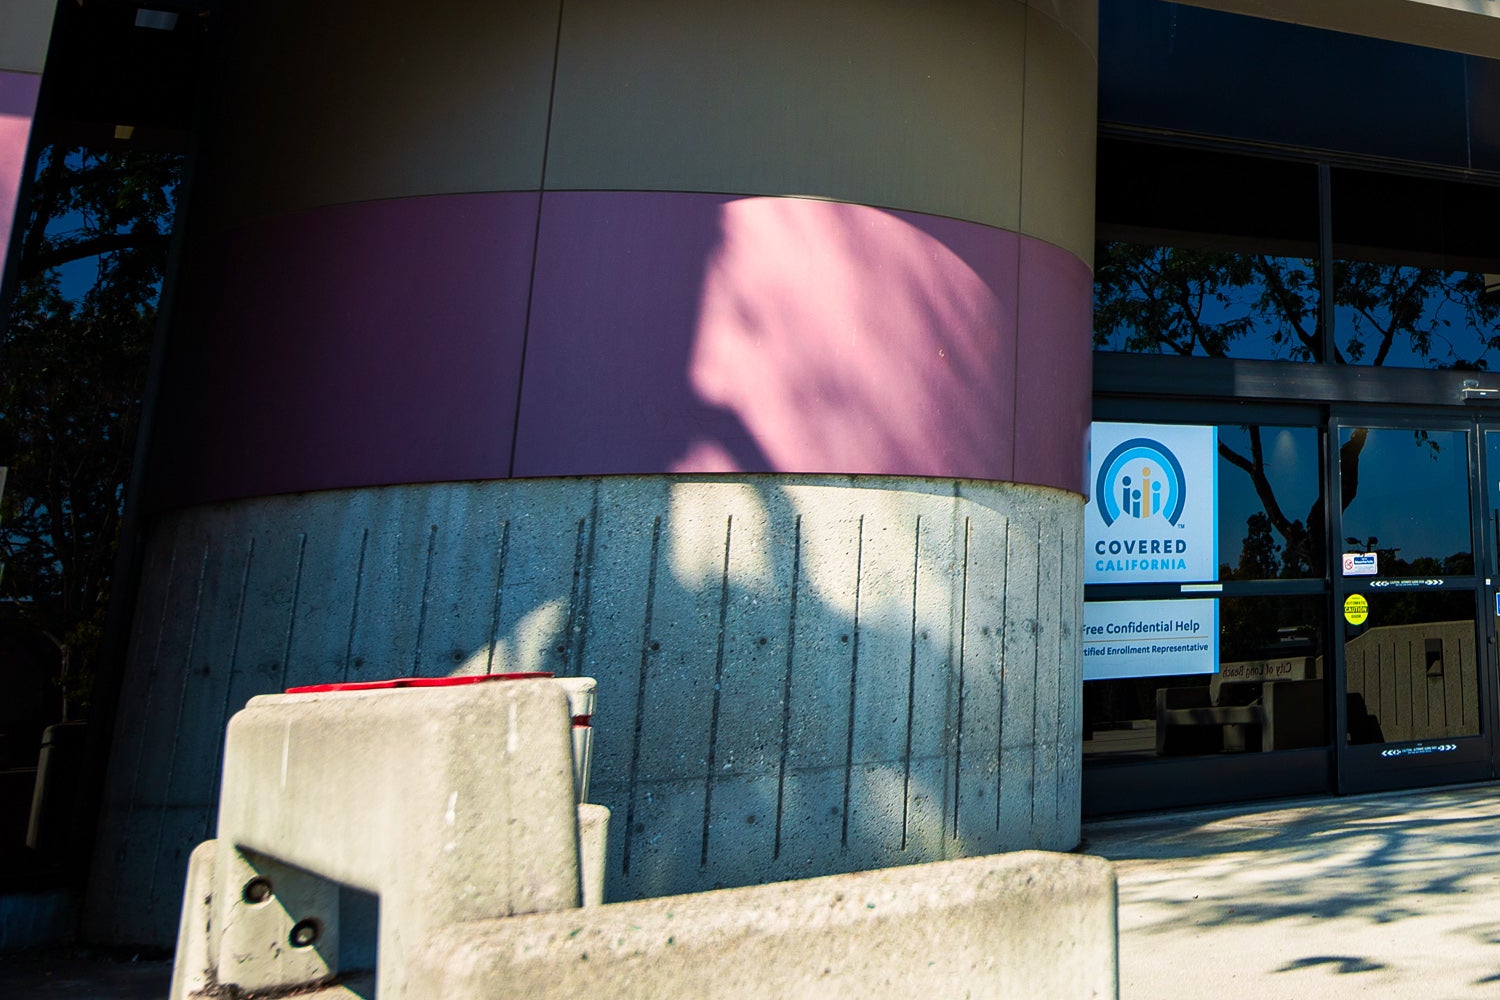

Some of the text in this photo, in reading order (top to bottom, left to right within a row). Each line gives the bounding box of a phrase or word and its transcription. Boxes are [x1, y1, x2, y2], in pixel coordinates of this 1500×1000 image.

[1095, 539, 1187, 555] COVERED
[1095, 558, 1187, 572] CALIFORNIA
[1106, 620, 1173, 634] Confidential
[1175, 619, 1200, 633] Help
[1083, 643, 1209, 657] tified Enrollment Representative
